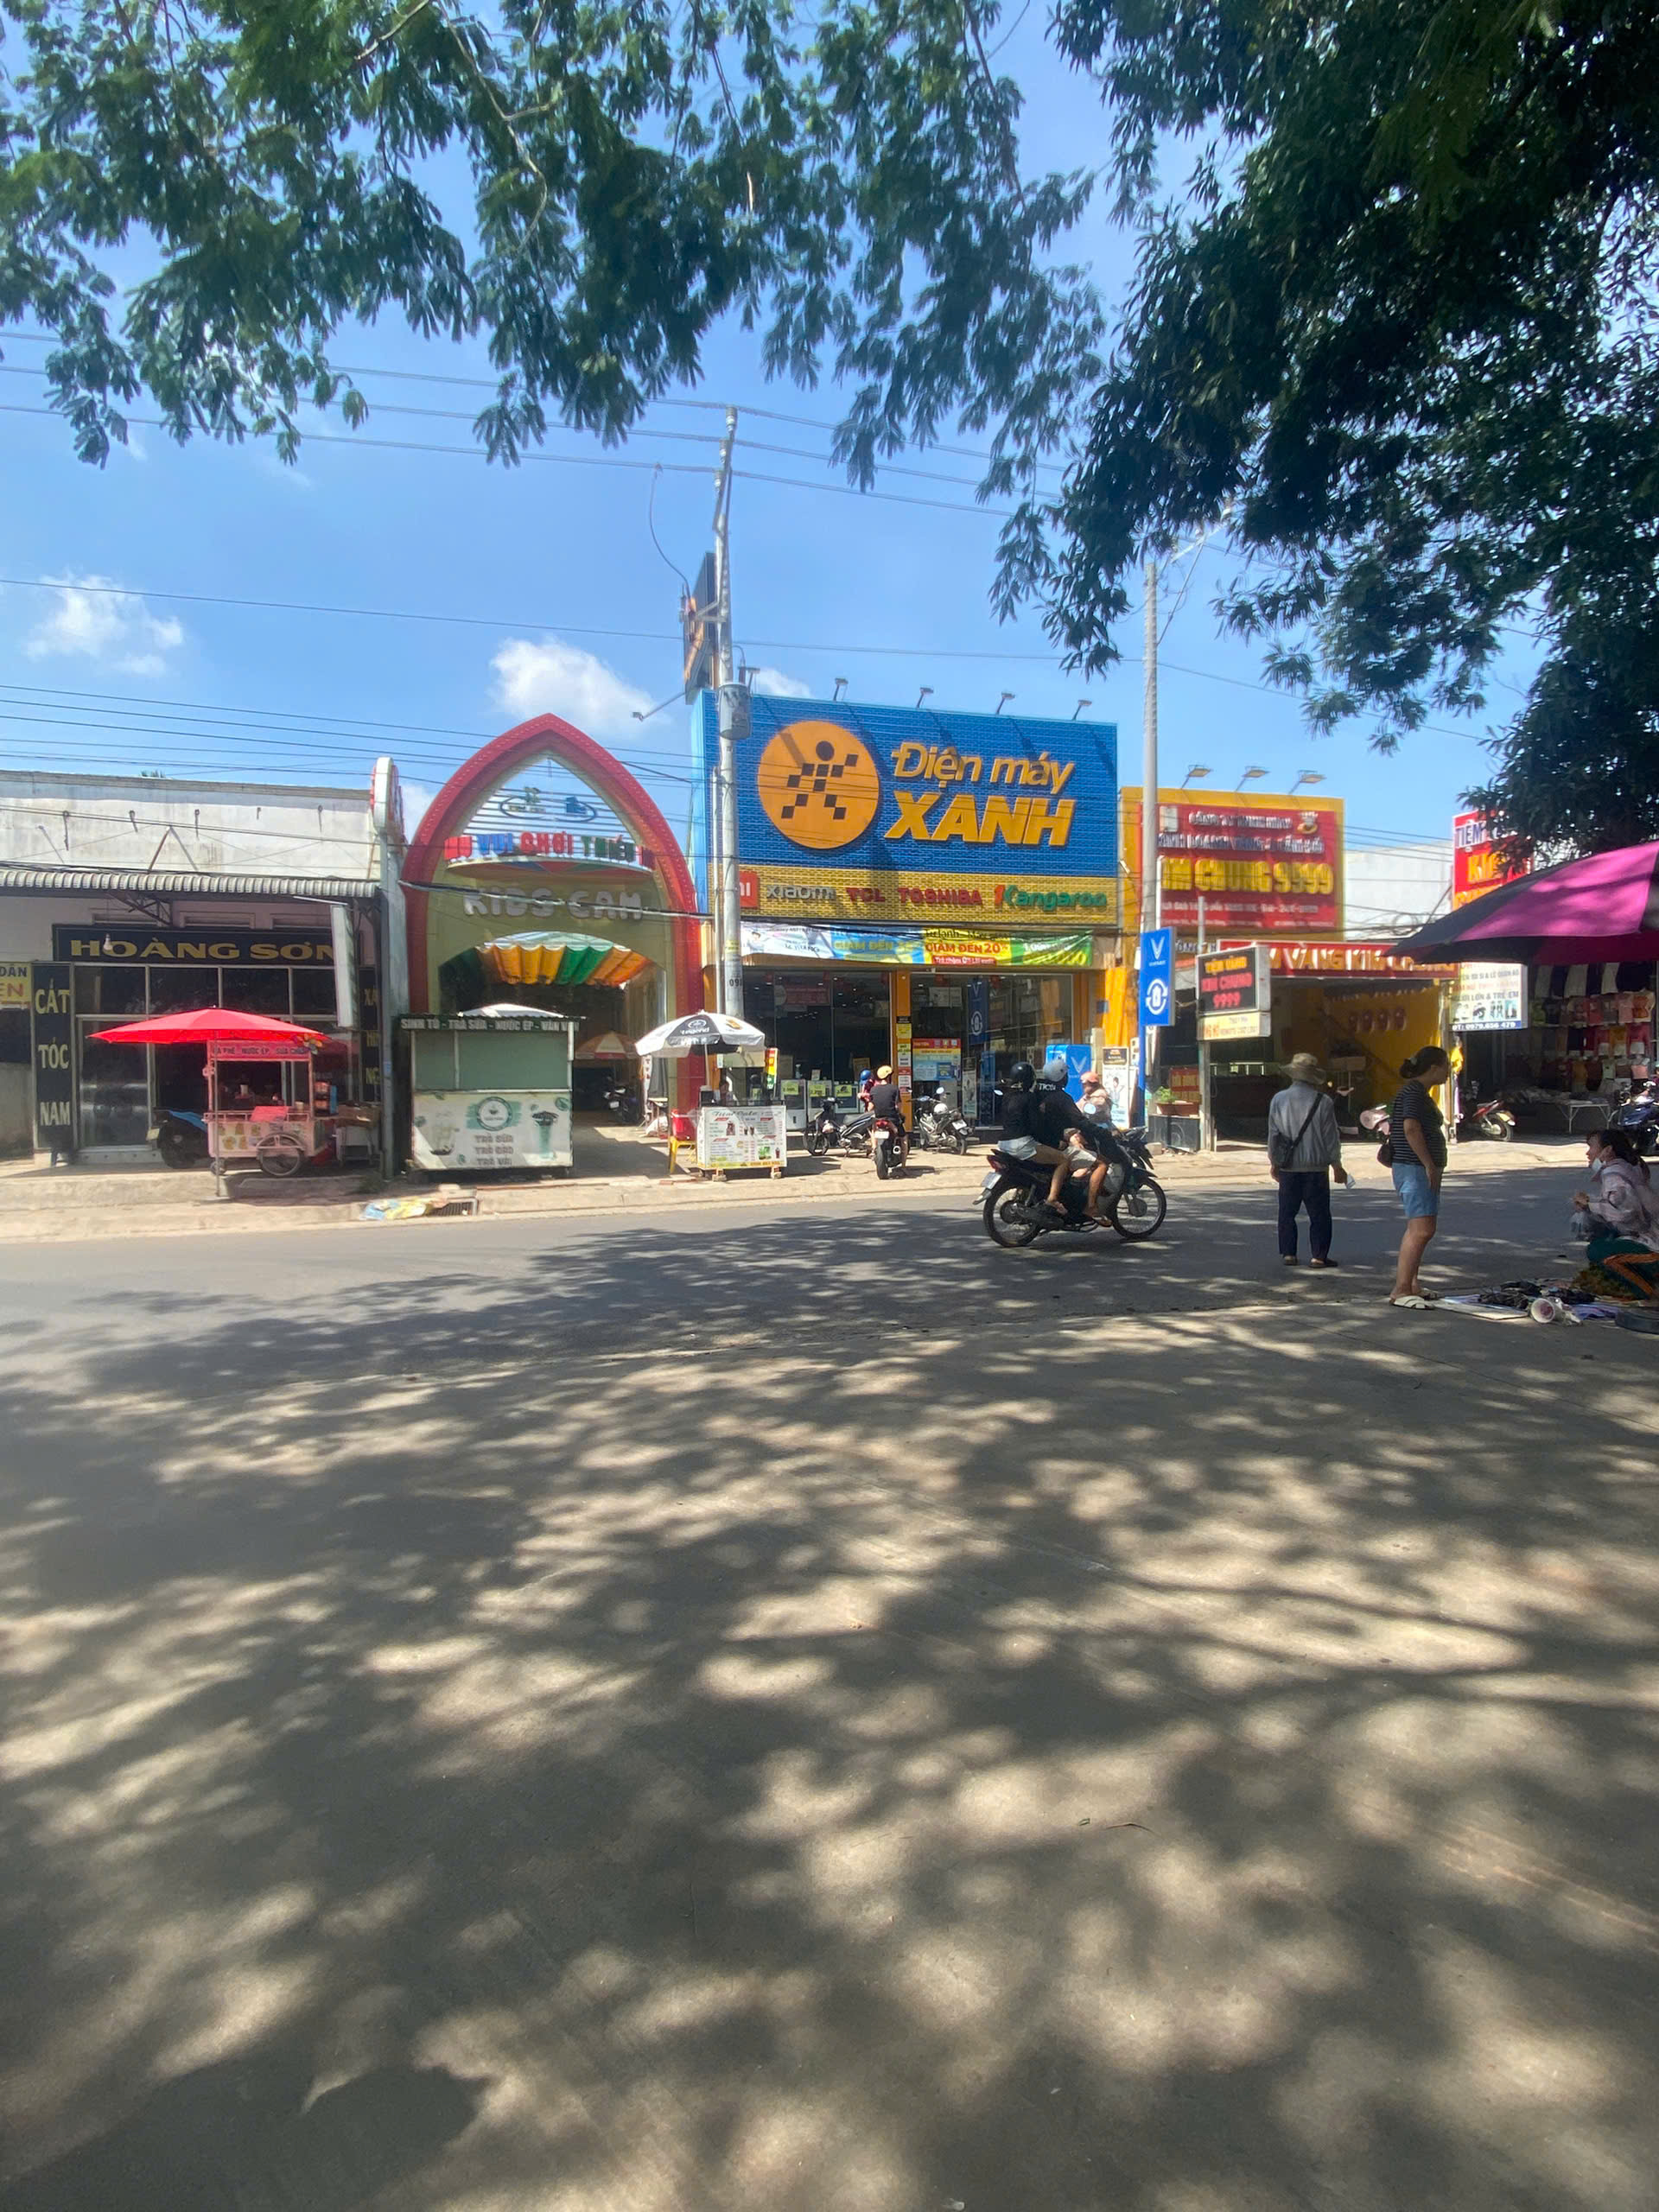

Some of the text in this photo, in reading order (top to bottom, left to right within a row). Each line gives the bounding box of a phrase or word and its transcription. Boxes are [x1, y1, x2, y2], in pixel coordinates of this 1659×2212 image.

[891, 741, 1075, 795] Điện máy
[884, 790, 1076, 847] XANH
[463, 885, 554, 918] KIDS
[846, 887, 886, 903] TCL
[898, 887, 983, 906] TOSHIBA
[71, 937, 334, 961] HOÀNG SƠN
[38, 1036, 70, 1069] TÓC
[41, 1101, 70, 1126] NAM
